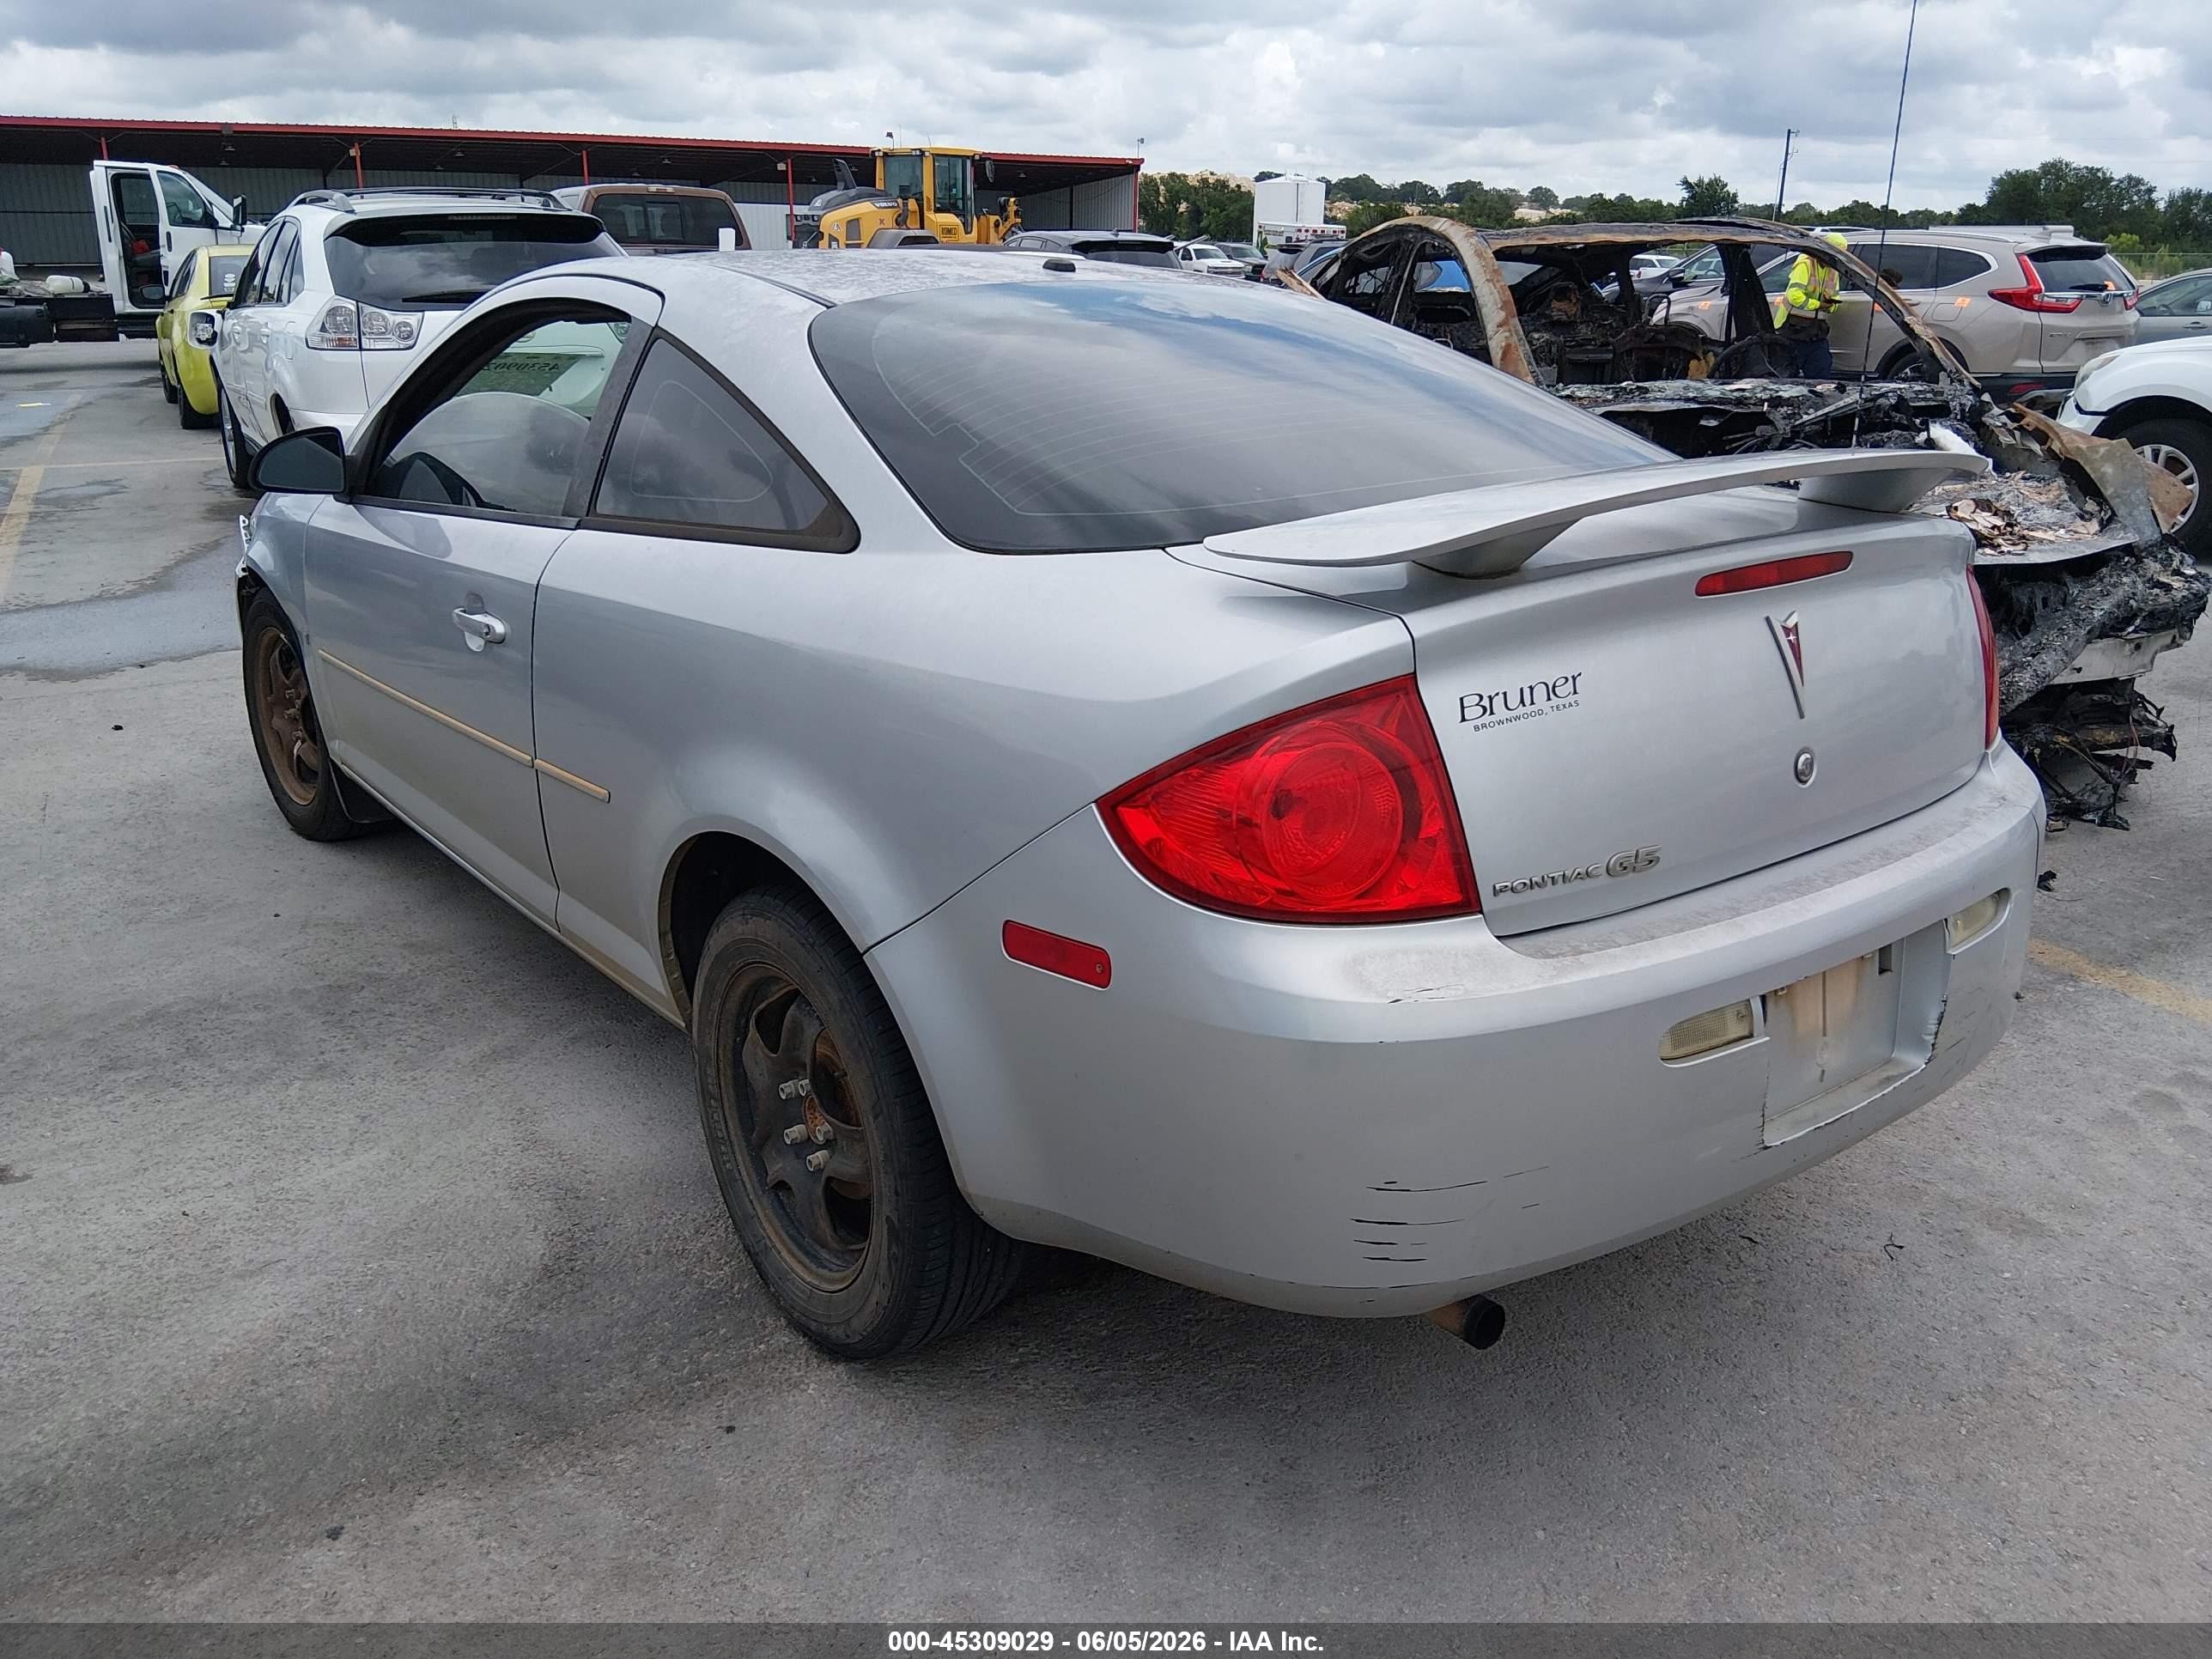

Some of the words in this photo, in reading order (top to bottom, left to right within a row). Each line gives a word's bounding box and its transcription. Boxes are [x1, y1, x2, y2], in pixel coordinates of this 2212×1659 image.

[1458, 672, 1583, 724] Bruner
[1473, 708, 1548, 732] BROWNWOOD,
[1549, 699, 1580, 713] TEXAS
[1492, 862, 1602, 897] PONTIAC
[1606, 844, 1662, 878] G5
